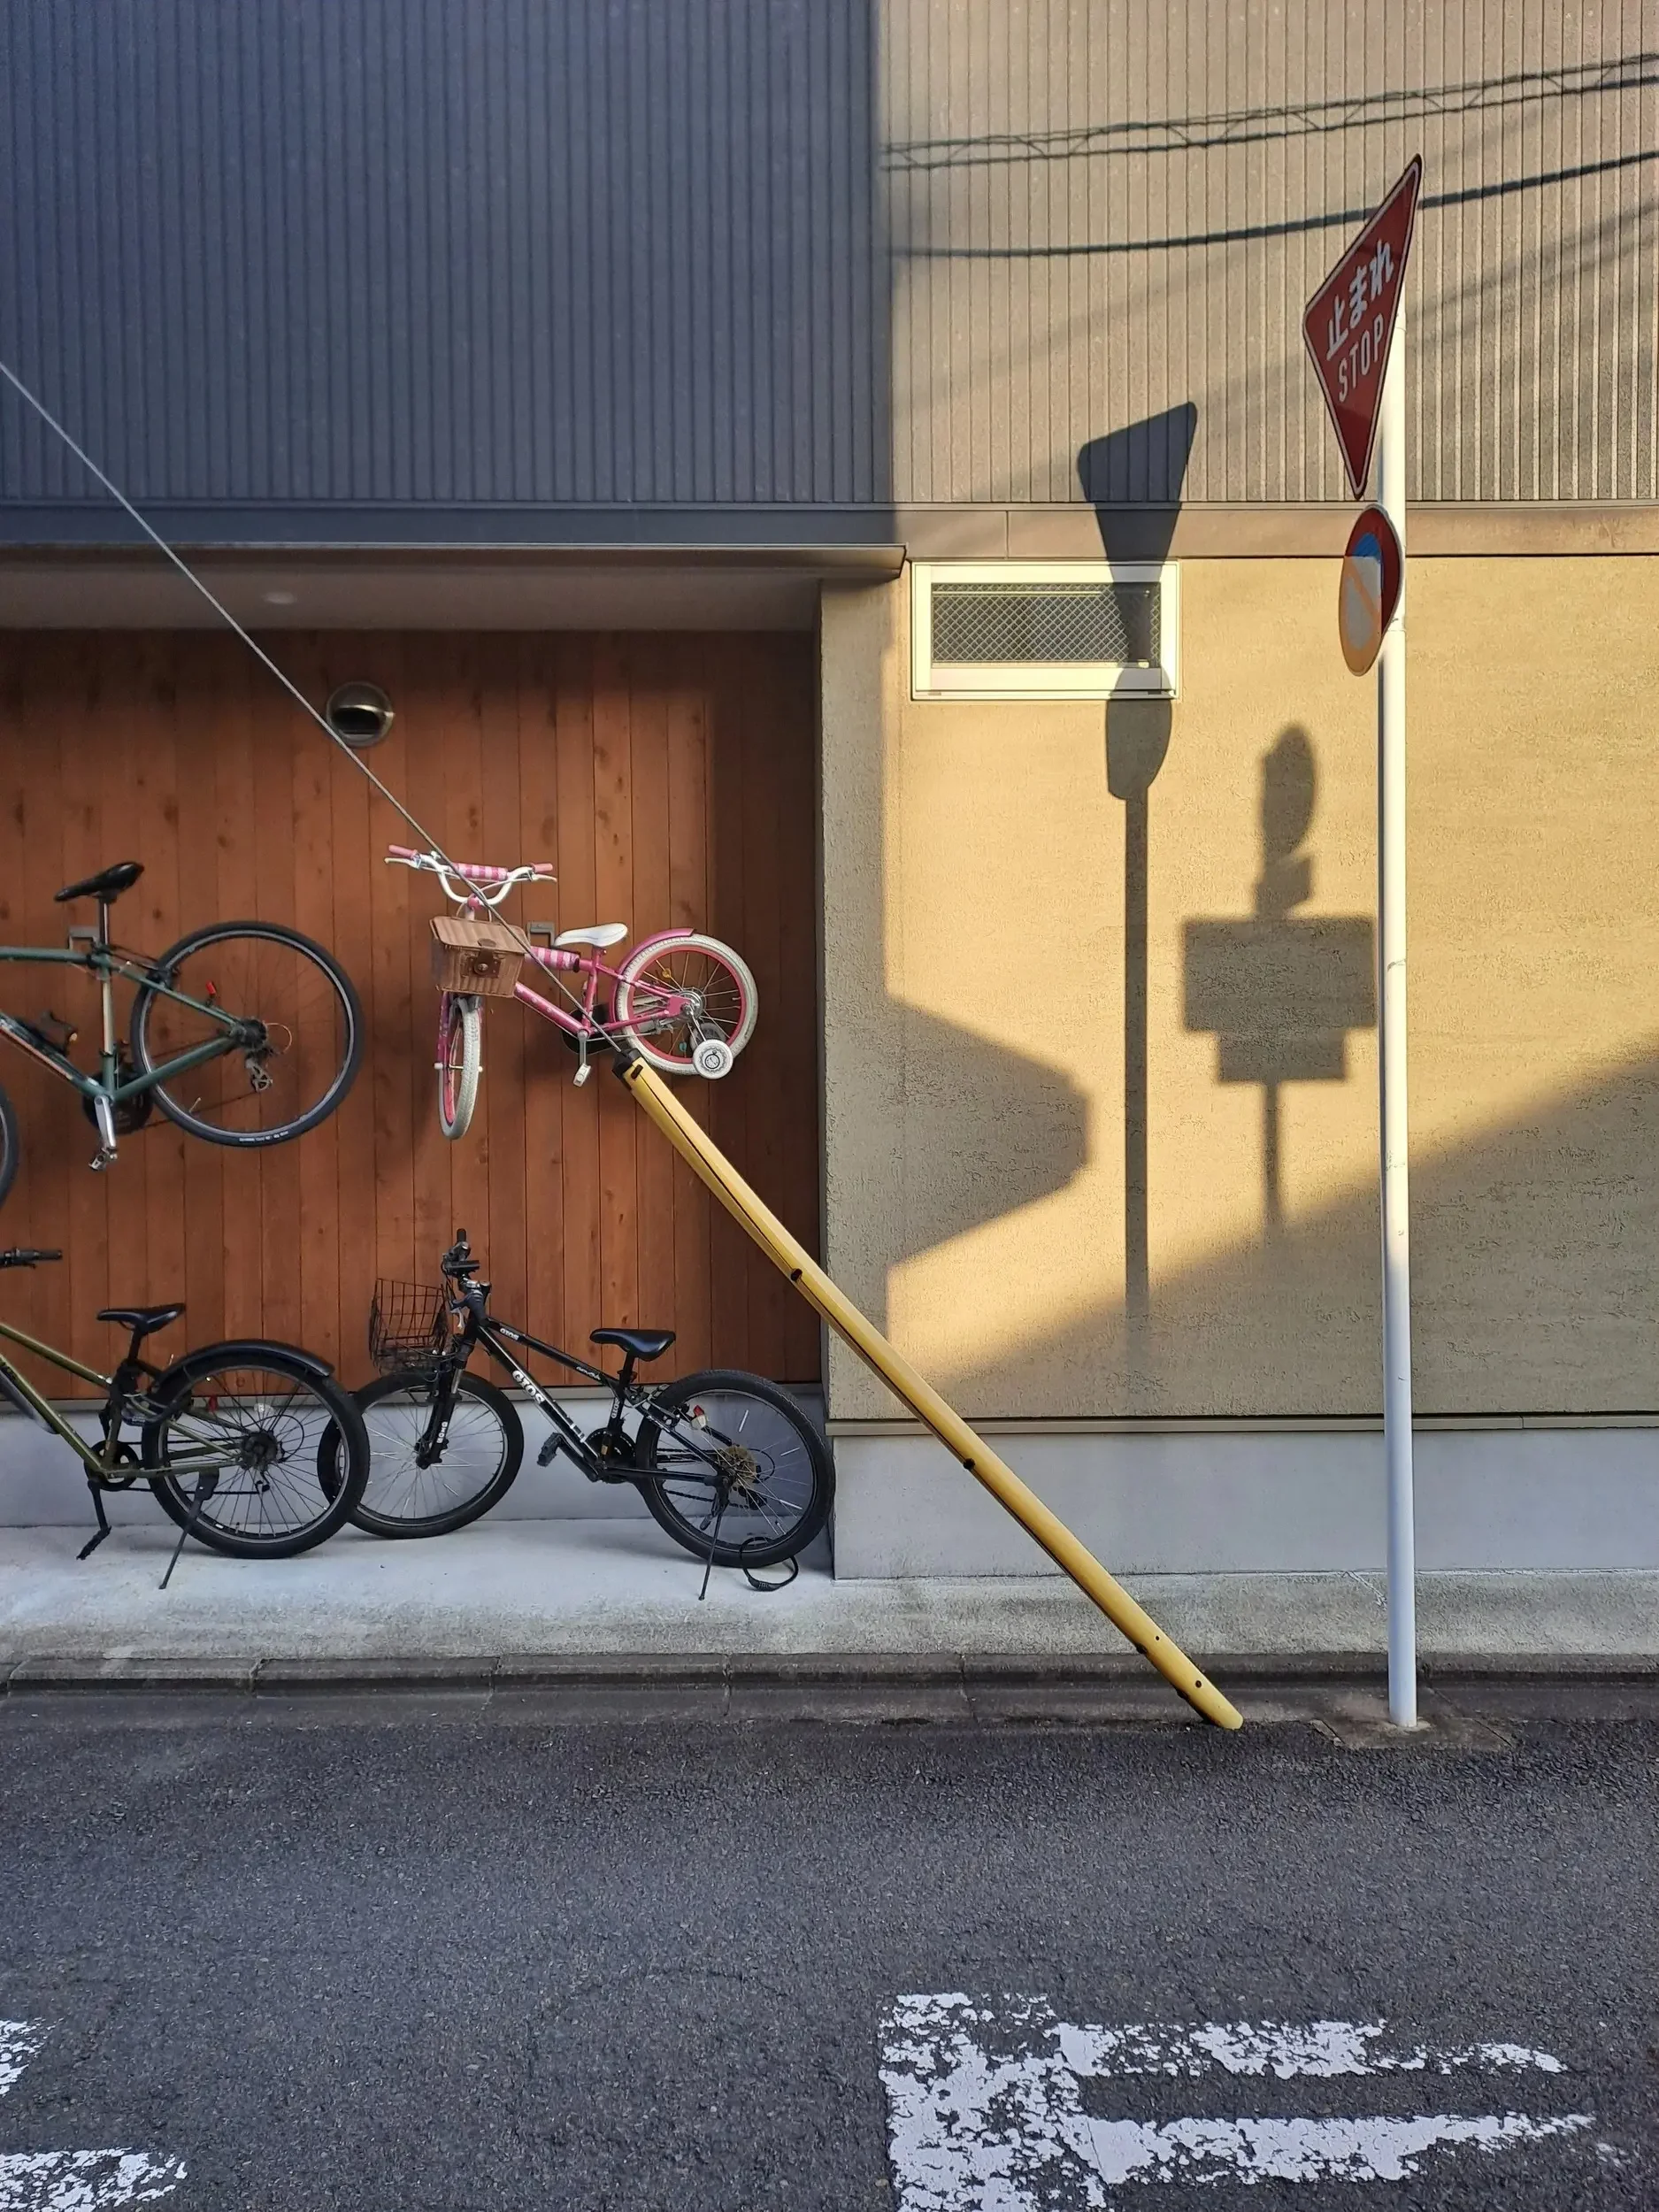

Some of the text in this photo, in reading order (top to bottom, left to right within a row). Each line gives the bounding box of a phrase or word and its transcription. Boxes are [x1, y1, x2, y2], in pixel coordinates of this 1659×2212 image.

[1326, 240, 1394, 361] 止まれ
[1338, 312, 1384, 403] STOP
[512, 1370, 545, 1404] GIOS
[611, 1398, 621, 1419] GIOS
[436, 1421, 448, 1443] GIOS
